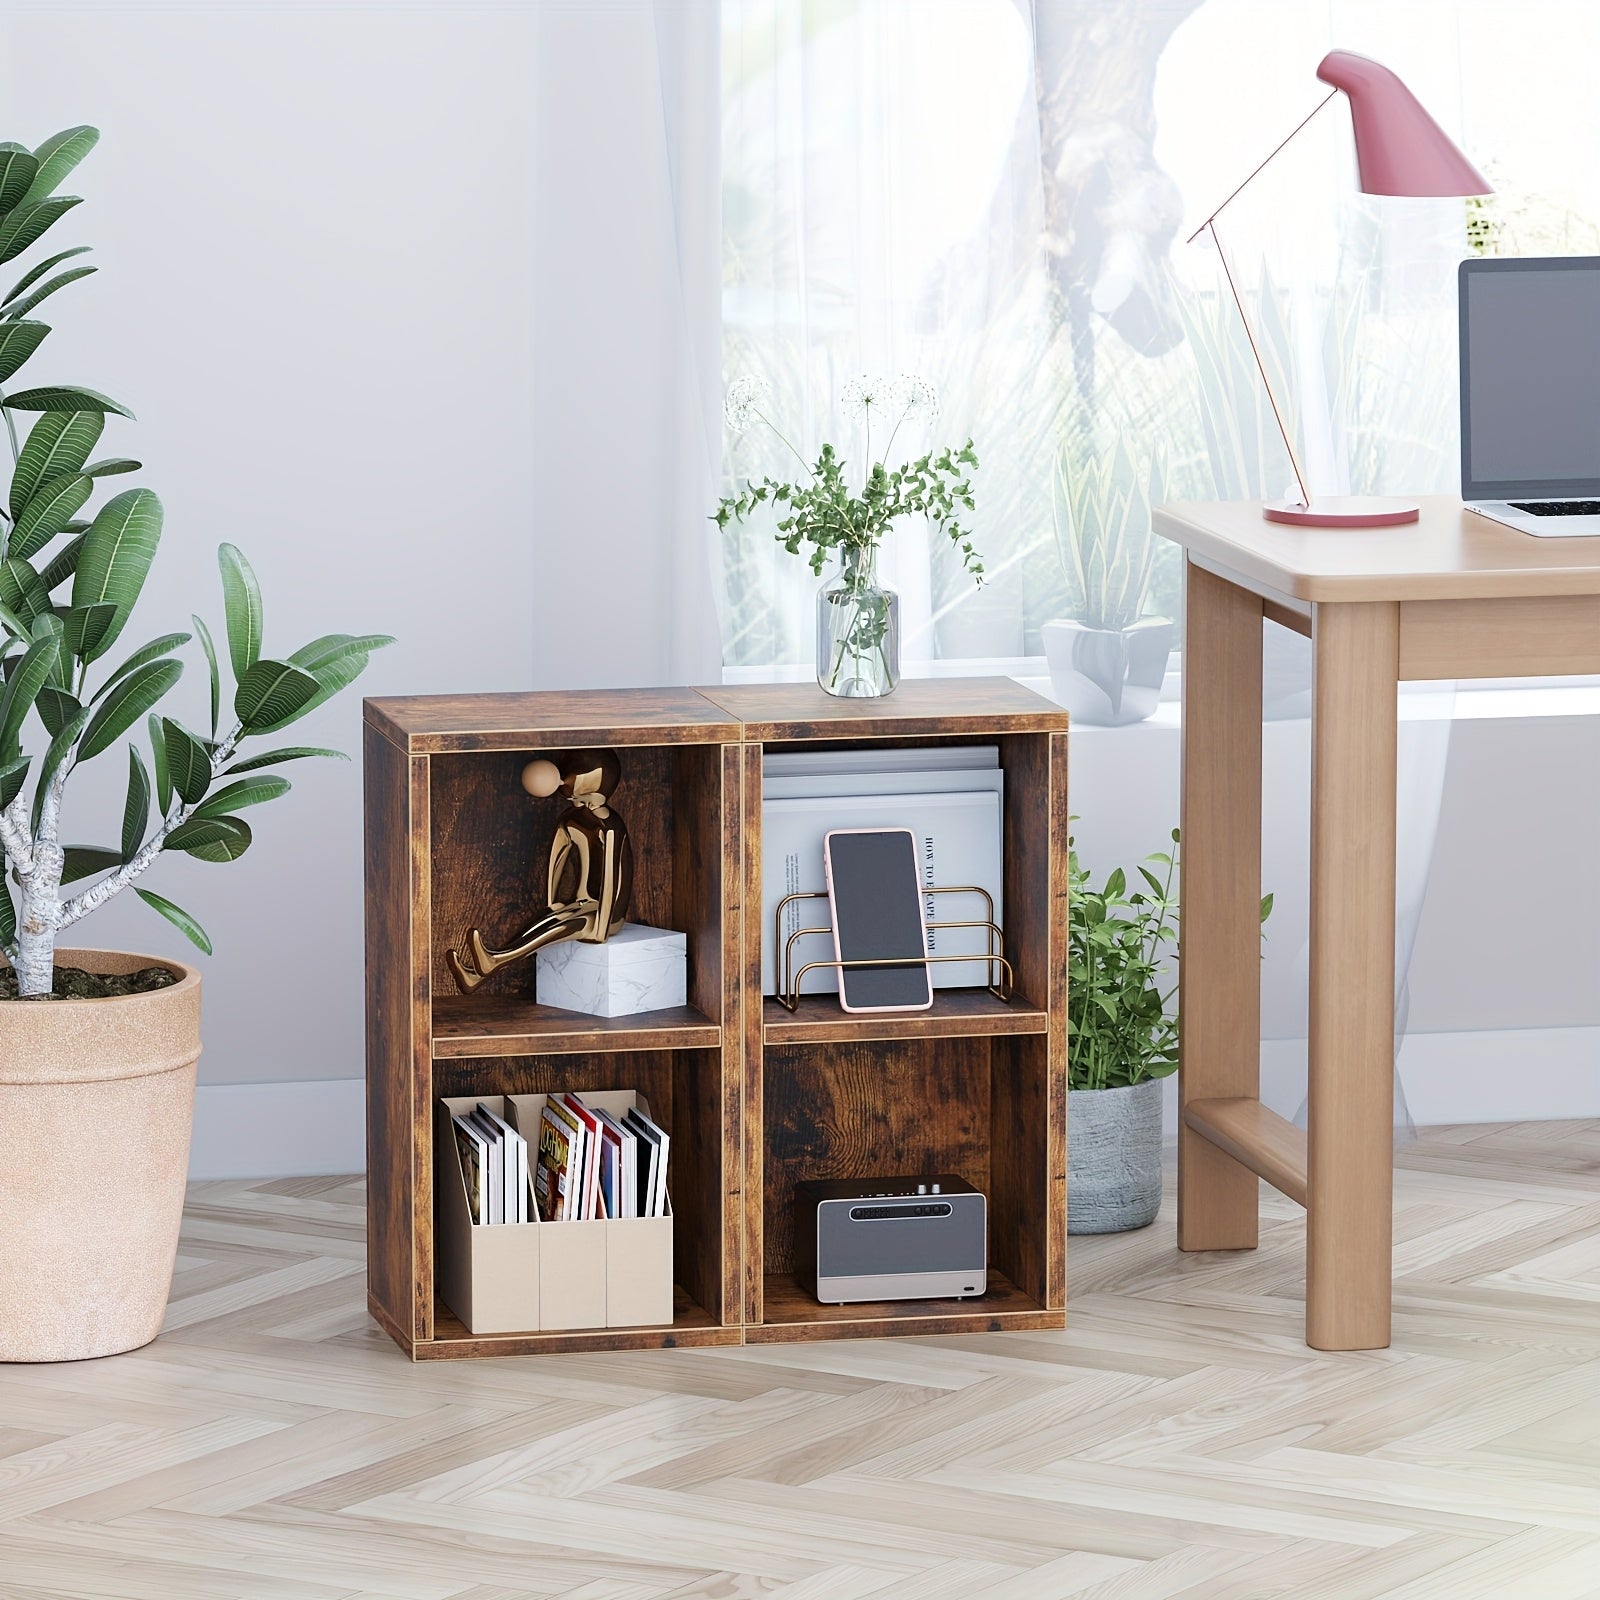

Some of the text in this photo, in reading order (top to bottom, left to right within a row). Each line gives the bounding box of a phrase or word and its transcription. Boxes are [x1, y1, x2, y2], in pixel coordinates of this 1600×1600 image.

[925, 837, 935, 950] HOW TO ECAPE ROM
